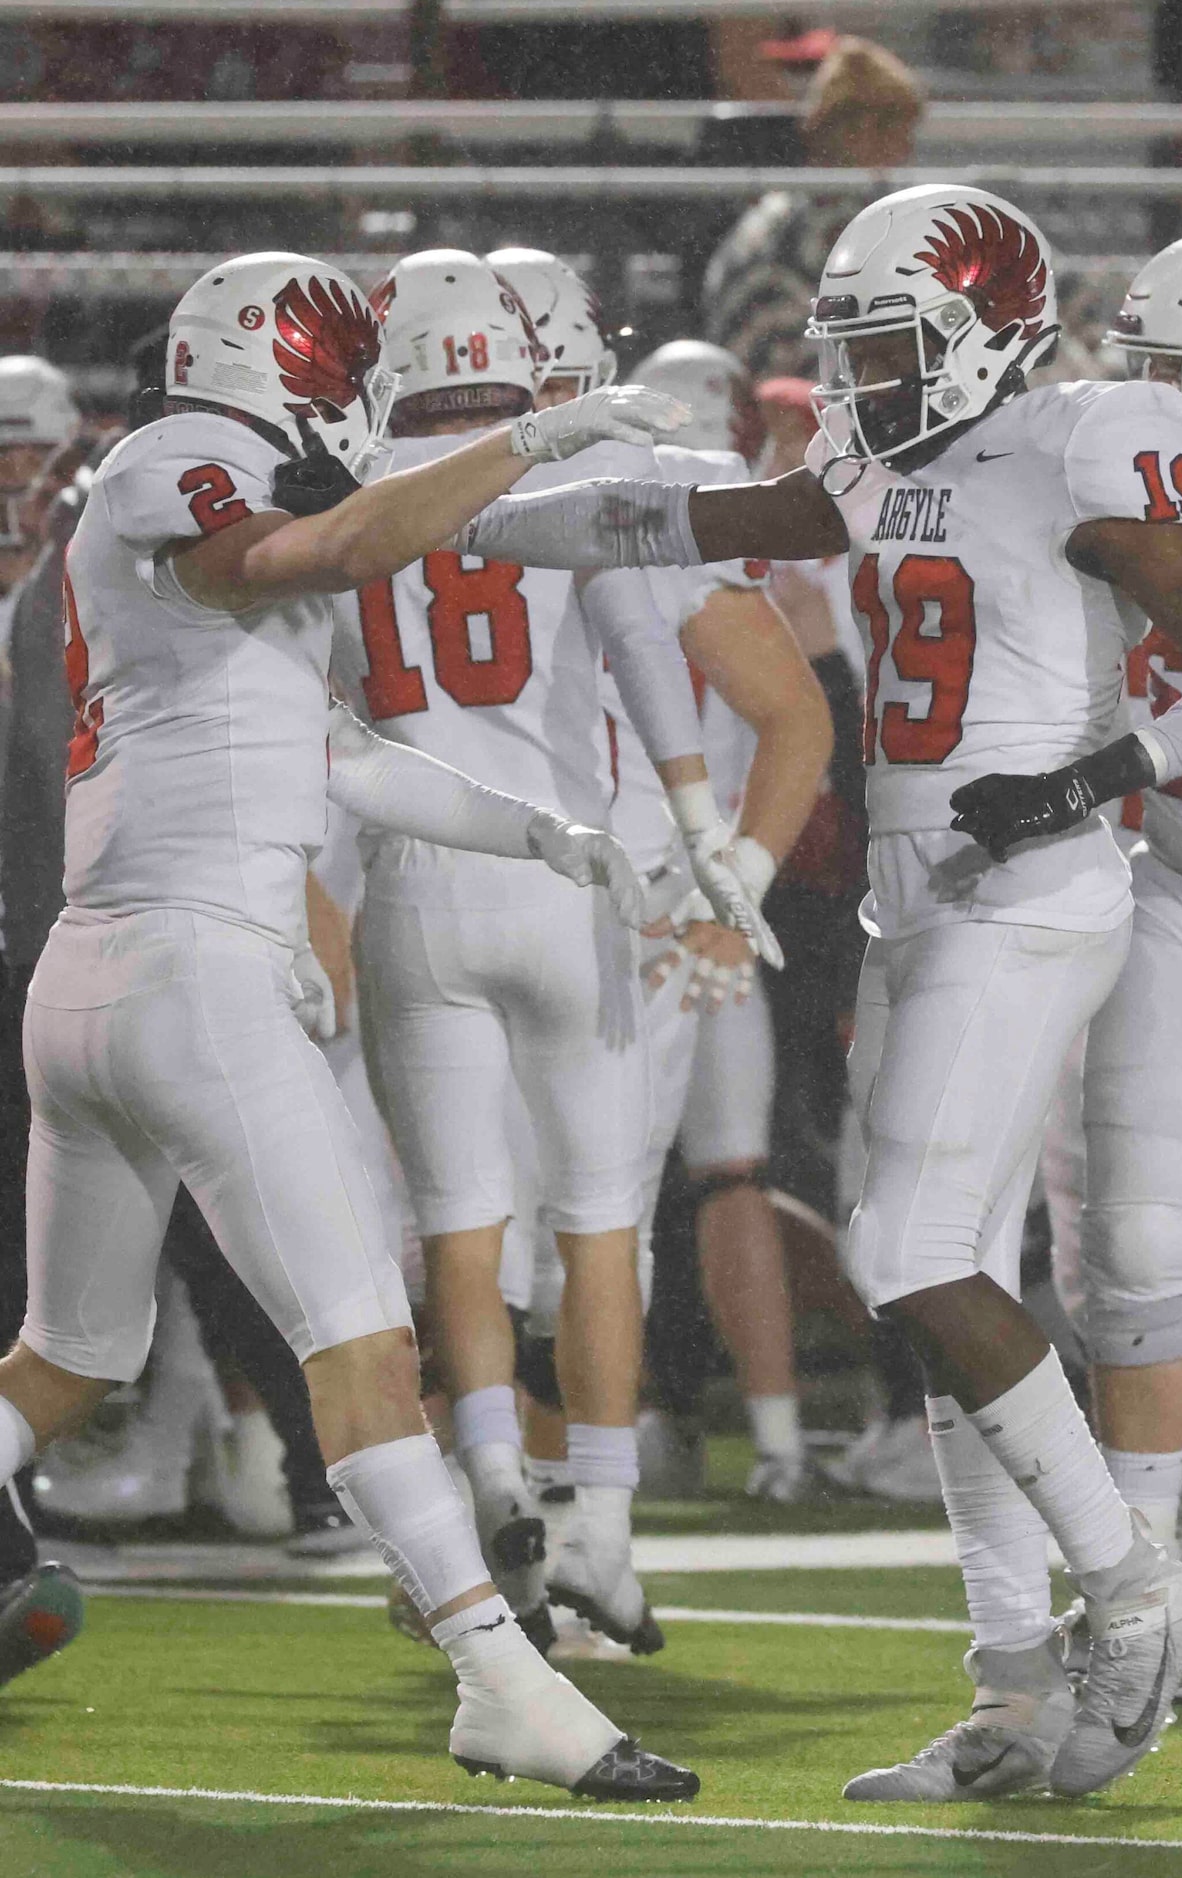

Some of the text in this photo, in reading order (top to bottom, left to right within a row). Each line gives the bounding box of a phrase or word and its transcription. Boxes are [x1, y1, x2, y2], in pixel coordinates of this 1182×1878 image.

[442, 331, 490, 377] 18
[177, 463, 254, 535] 2
[871, 487, 953, 543] ARGYLE
[356, 549, 533, 722] 18
[853, 553, 976, 765] 19
[1107, 1615, 1144, 1630] ALPHA
